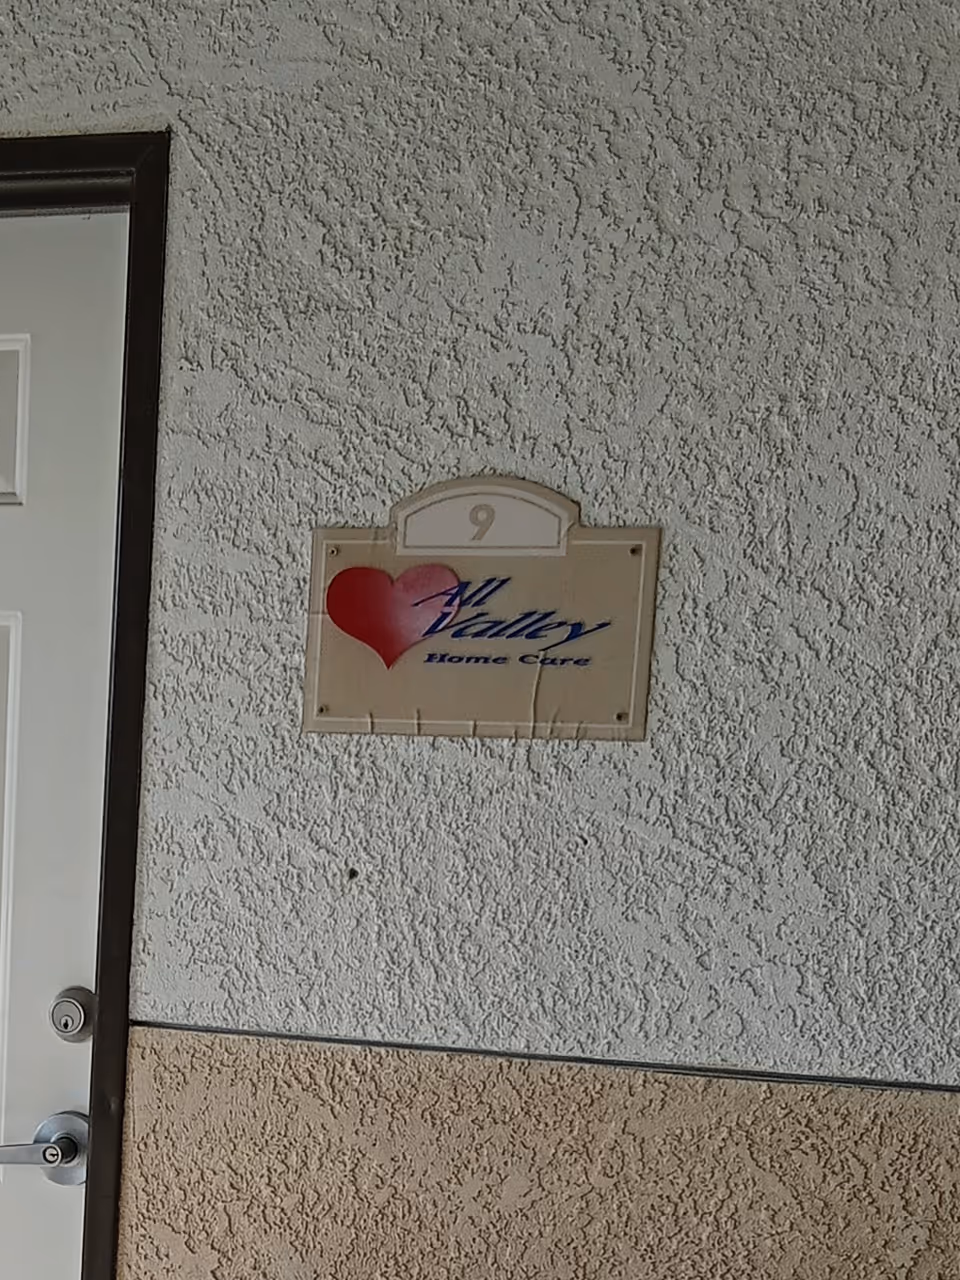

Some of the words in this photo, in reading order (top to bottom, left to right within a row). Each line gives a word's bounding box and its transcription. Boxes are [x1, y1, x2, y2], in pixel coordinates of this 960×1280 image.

[468, 503, 496, 542] 9
[411, 576, 512, 608] All
[421, 610, 612, 652] Valley
[423, 652, 508, 666] Home
[518, 652, 591, 667] Care
